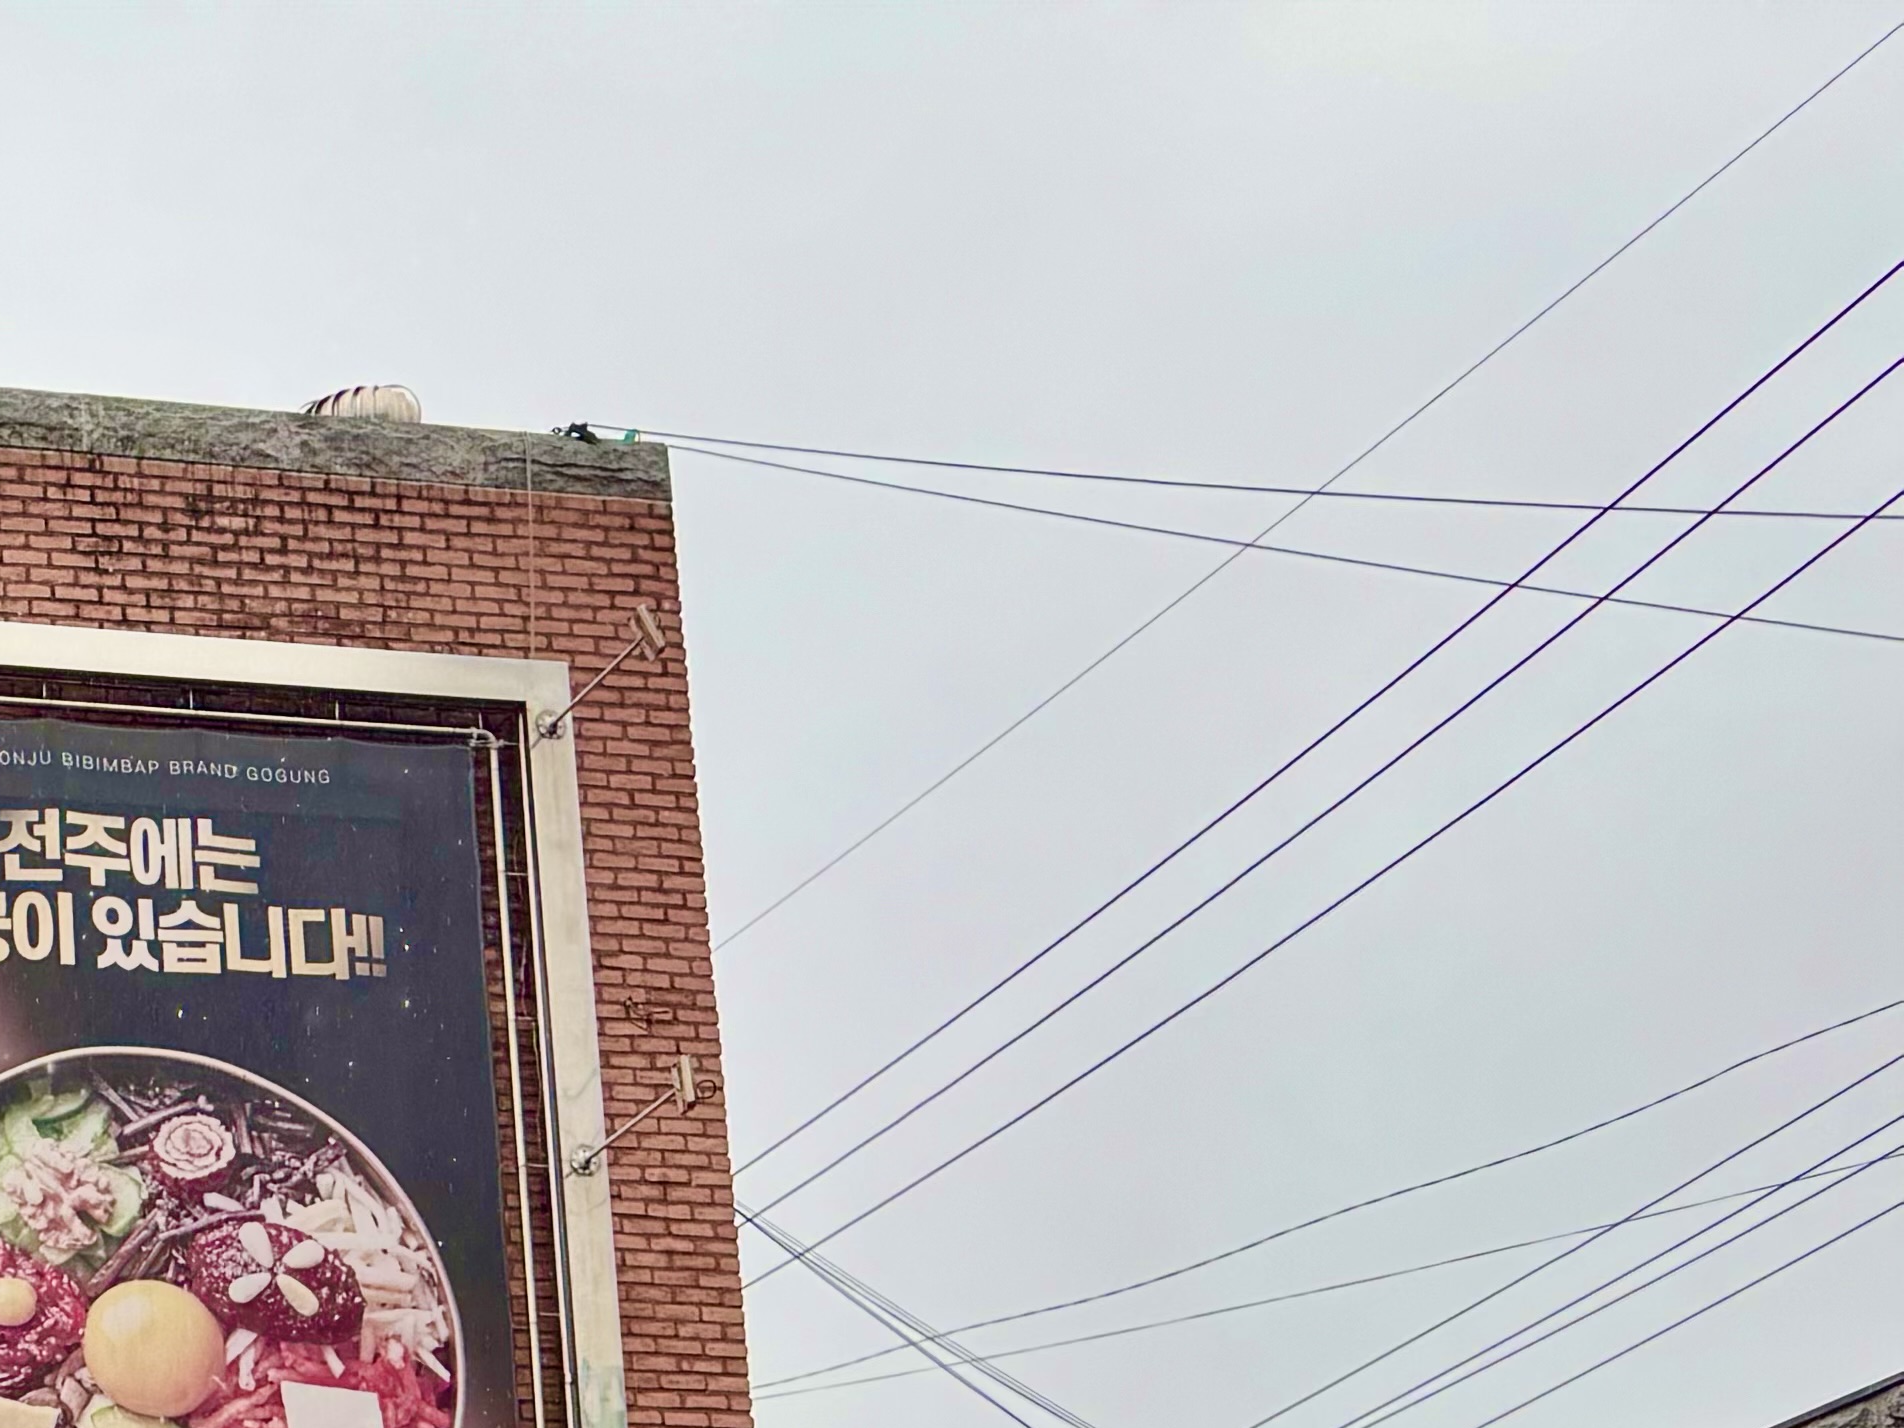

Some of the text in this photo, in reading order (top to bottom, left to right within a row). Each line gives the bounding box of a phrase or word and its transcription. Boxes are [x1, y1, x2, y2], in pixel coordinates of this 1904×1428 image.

[61, 751, 160, 775] BIBIMBAP
[169, 759, 238, 780] BRAND
[246, 766, 331, 784] GOGUNG
[91, 896, 387, 981] 있습니다!!
